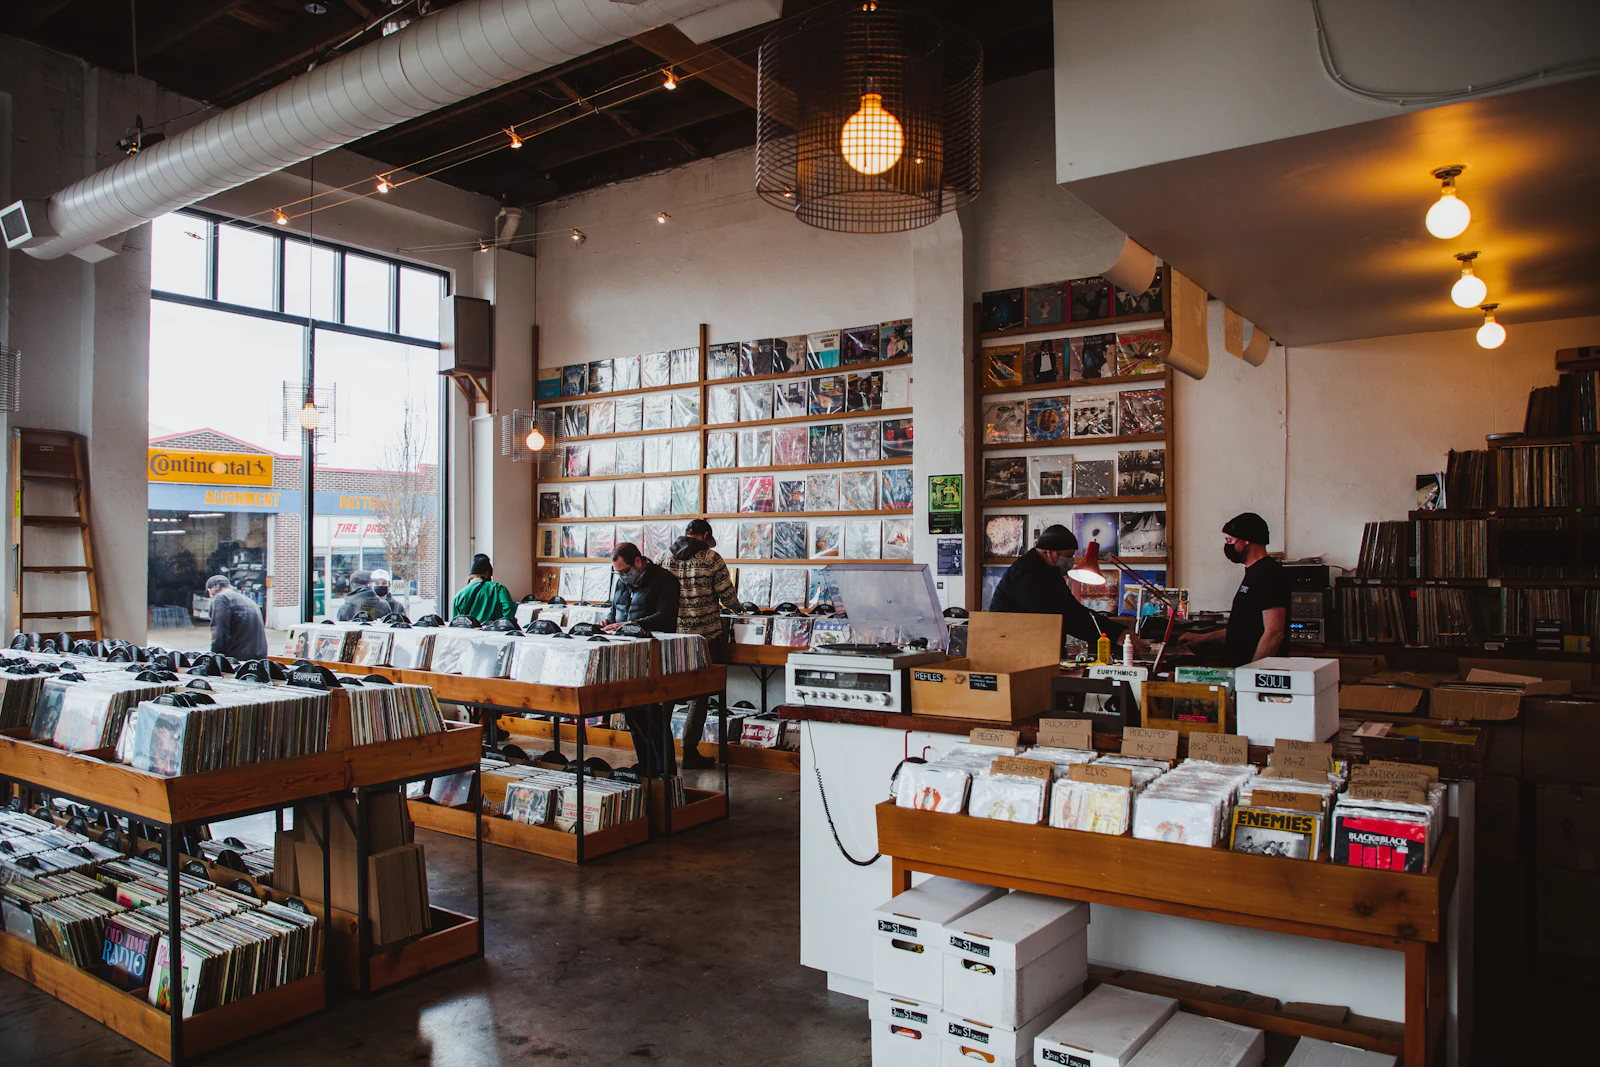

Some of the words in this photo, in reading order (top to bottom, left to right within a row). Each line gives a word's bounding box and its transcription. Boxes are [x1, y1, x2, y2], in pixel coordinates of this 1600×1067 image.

[204, 490, 281, 507] ALIGNMENT
[334, 523, 358, 539] TIRE
[915, 671, 942, 682] REFILES
[1097, 668, 1138, 677] EURYTHMICS
[1258, 674, 1291, 688] SOUL
[1044, 719, 1081, 728] ROCK/POP
[746, 728, 758, 736] surf
[977, 732, 1004, 742] RECENT
[1129, 728, 1170, 739] ROCK/POP
[1206, 734, 1228, 743] SOUL
[1136, 743, 1154, 753] M-Z
[1190, 742, 1208, 751] R&B
[1219, 745, 1244, 755] FUNK
[1287, 741, 1312, 751] INDIE
[1284, 757, 1305, 766] M-Z
[995, 762, 1021, 772] BEACH
[1022, 765, 1044, 776] BOYS
[1085, 766, 1108, 777] ELVIS
[1271, 793, 1298, 803] PUNK
[1237, 811, 1312, 831] ENEMIES
[1348, 832, 1375, 843] BLACK
[1380, 836, 1408, 846] BLACK
[879, 920, 885, 930] 3
[104, 926, 123, 945] OLD
[125, 933, 149, 956] TIME
[950, 935, 955, 945] 3
[101, 940, 146, 976] RADIO
[892, 1007, 896, 1017] 3
[949, 1022, 954, 1033] 3
[1045, 1048, 1050, 1059] 3
